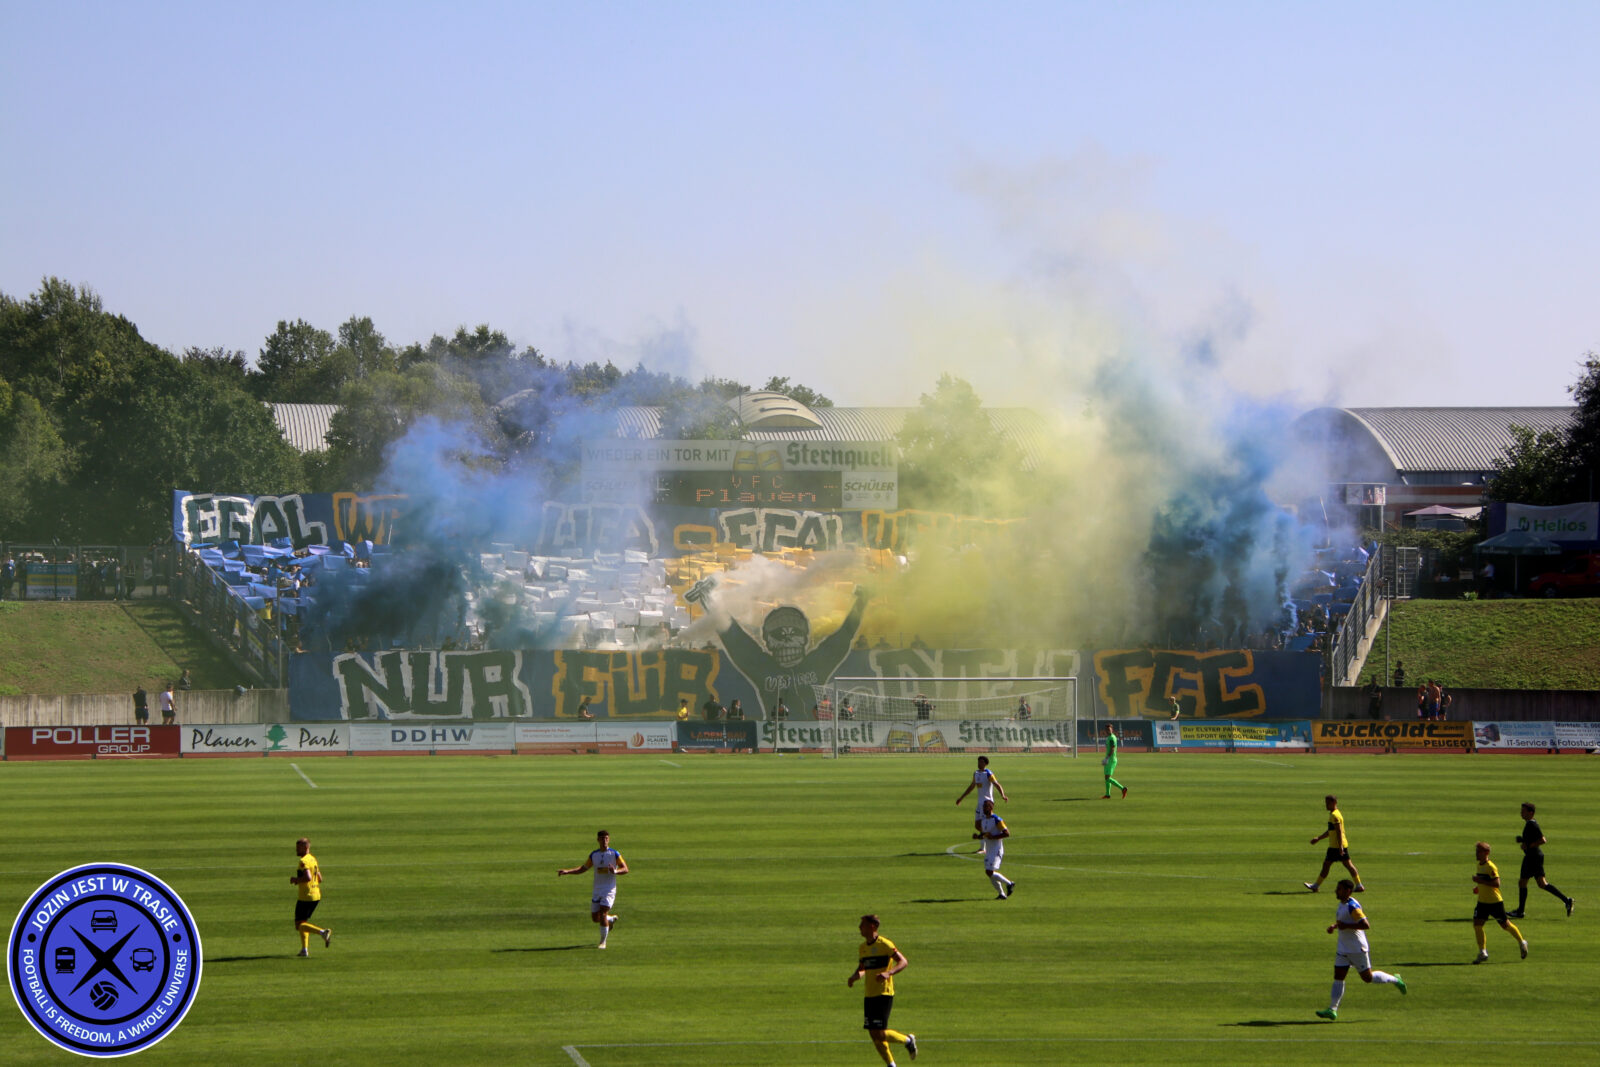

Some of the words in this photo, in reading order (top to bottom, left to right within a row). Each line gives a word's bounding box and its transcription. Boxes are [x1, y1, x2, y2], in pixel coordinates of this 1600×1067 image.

[587, 448, 642, 461] WIEDER
[647, 448, 670, 461] EIN
[674, 448, 701, 461] TOR
[706, 448, 731, 461] MIT
[786, 441, 895, 471] Sternquell
[844, 480, 895, 492] SCHÜLER
[696, 487, 817, 502] Plauen
[181, 493, 328, 554] EGAL
[1534, 518, 1588, 532] Helios
[332, 649, 534, 722] NUR
[552, 648, 722, 719] FÜR
[32, 726, 151, 745] POLLER
[391, 728, 474, 743] DDHW
[762, 720, 874, 747] Sternquell
[958, 720, 1071, 747] Sternquell
[1320, 722, 1440, 738] Rückoldt
[191, 727, 258, 750] Plauen
[299, 727, 340, 749] Park
[1342, 739, 1394, 748] PEUGEOT
[1424, 739, 1474, 748] PEUGEOT
[1506, 739, 1547, 747] IT-Service
[97, 744, 151, 754] GROUP
